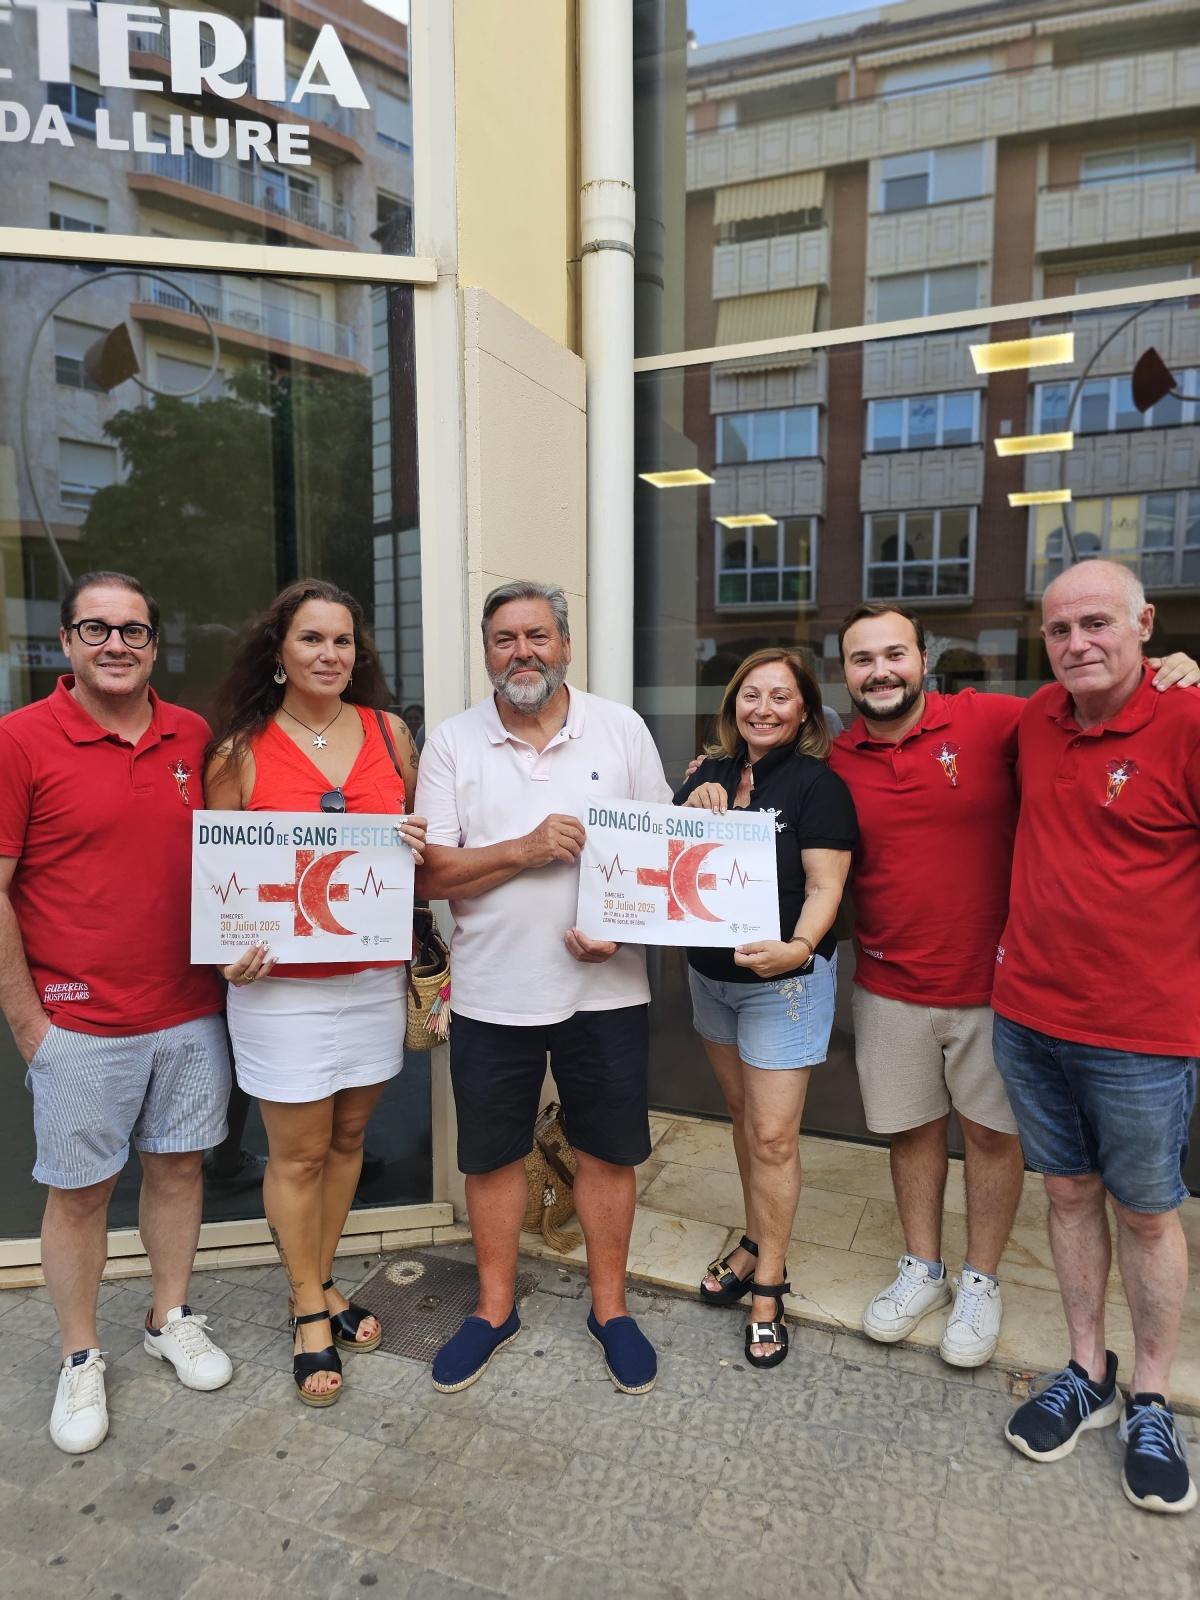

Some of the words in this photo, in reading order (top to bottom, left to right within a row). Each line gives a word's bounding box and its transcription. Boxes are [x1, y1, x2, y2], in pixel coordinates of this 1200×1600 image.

[96, 108, 311, 165] LLIURE
[588, 808, 651, 832] DONACIÓ
[652, 823, 663, 834] DE
[665, 818, 704, 838] SANG
[706, 822, 772, 842] FESTERA
[199, 821, 274, 846] DONACIÓ
[276, 833, 289, 845] DE
[292, 826, 337, 846] SANG
[604, 899, 614, 909] 30
[616, 900, 636, 911] Juliol
[637, 903, 655, 913] 2025
[220, 921, 231, 931] 30
[233, 921, 257, 931] Juliol
[259, 920, 280, 931] 2025
[45, 982, 88, 992] GUERRERS
[44, 992, 90, 1002] HOSPITALARIS
